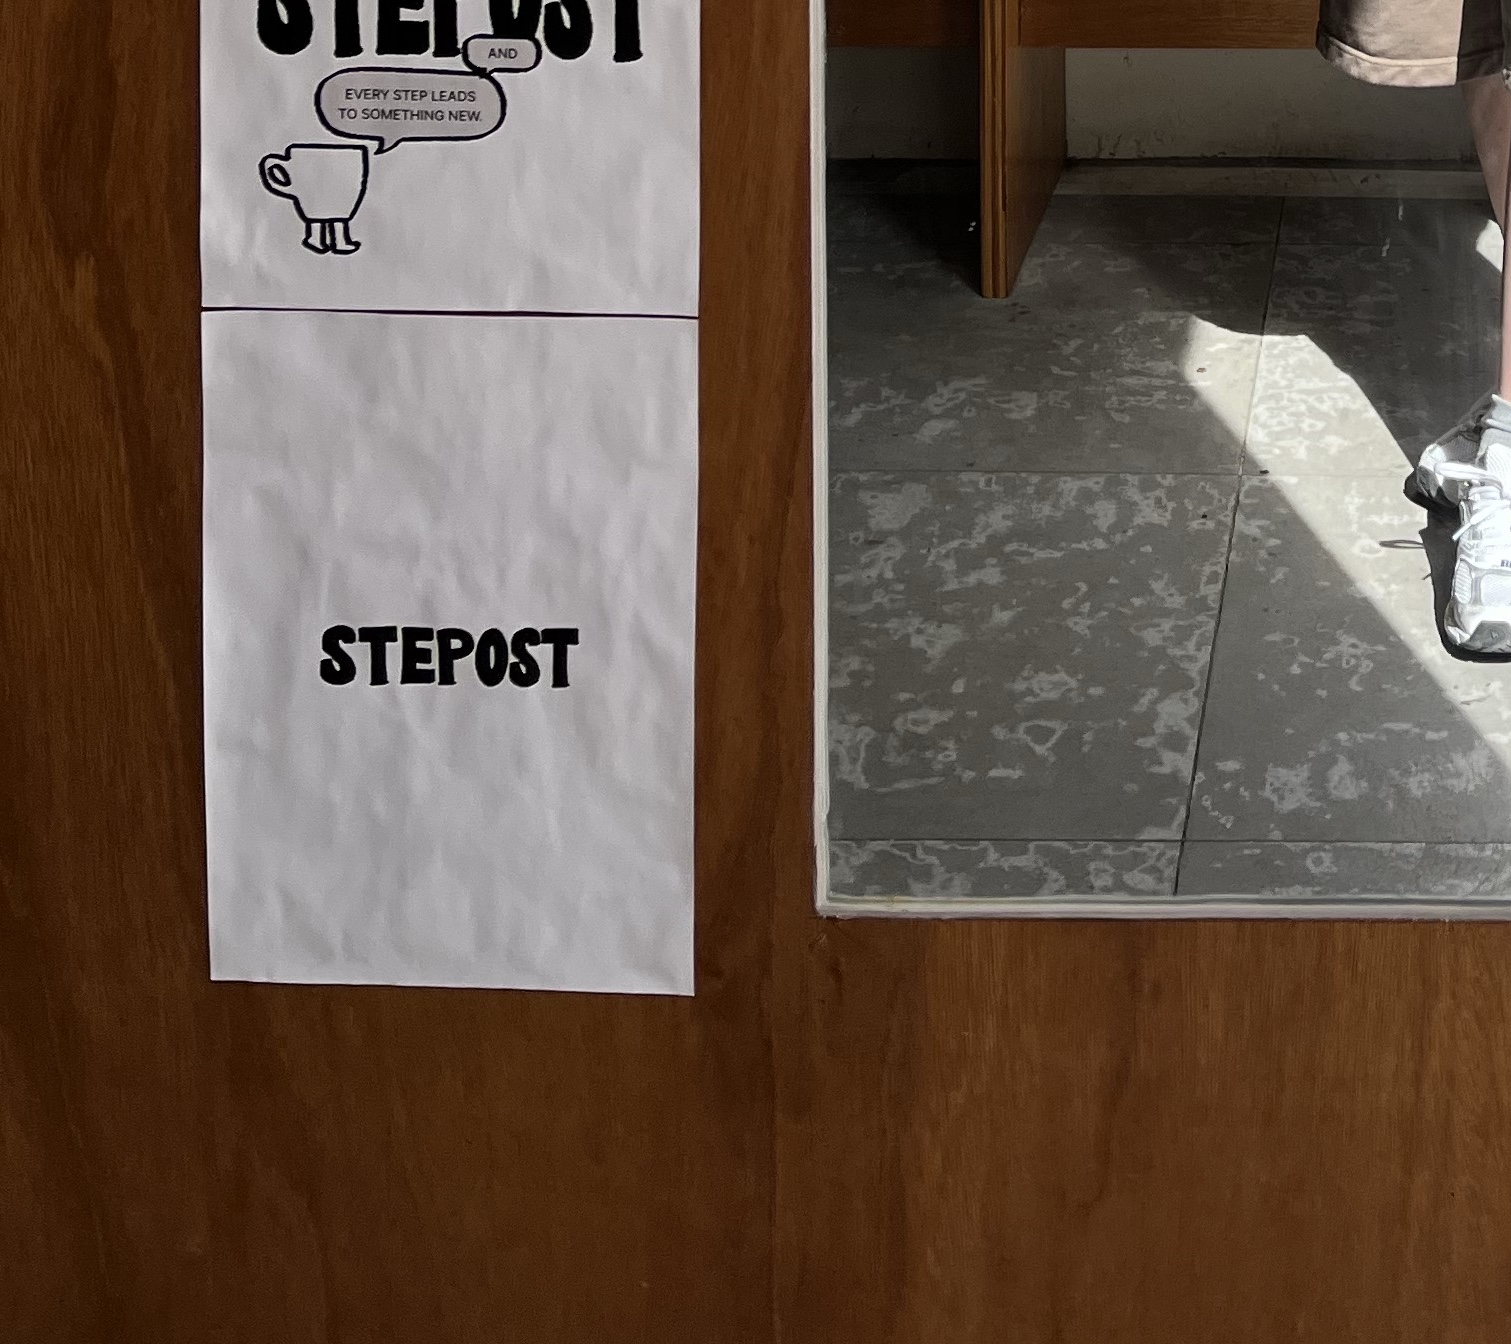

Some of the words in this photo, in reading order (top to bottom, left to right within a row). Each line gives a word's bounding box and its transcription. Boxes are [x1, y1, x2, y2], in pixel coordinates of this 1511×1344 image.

[487, 47, 519, 60] AND
[344, 88, 390, 102] EVERY
[392, 89, 428, 102] STEP
[431, 90, 477, 103] LEADS
[337, 107, 358, 120] TO
[361, 108, 445, 122] SOMETHING
[448, 110, 482, 123] NEW.
[319, 624, 580, 689] STEPOST
